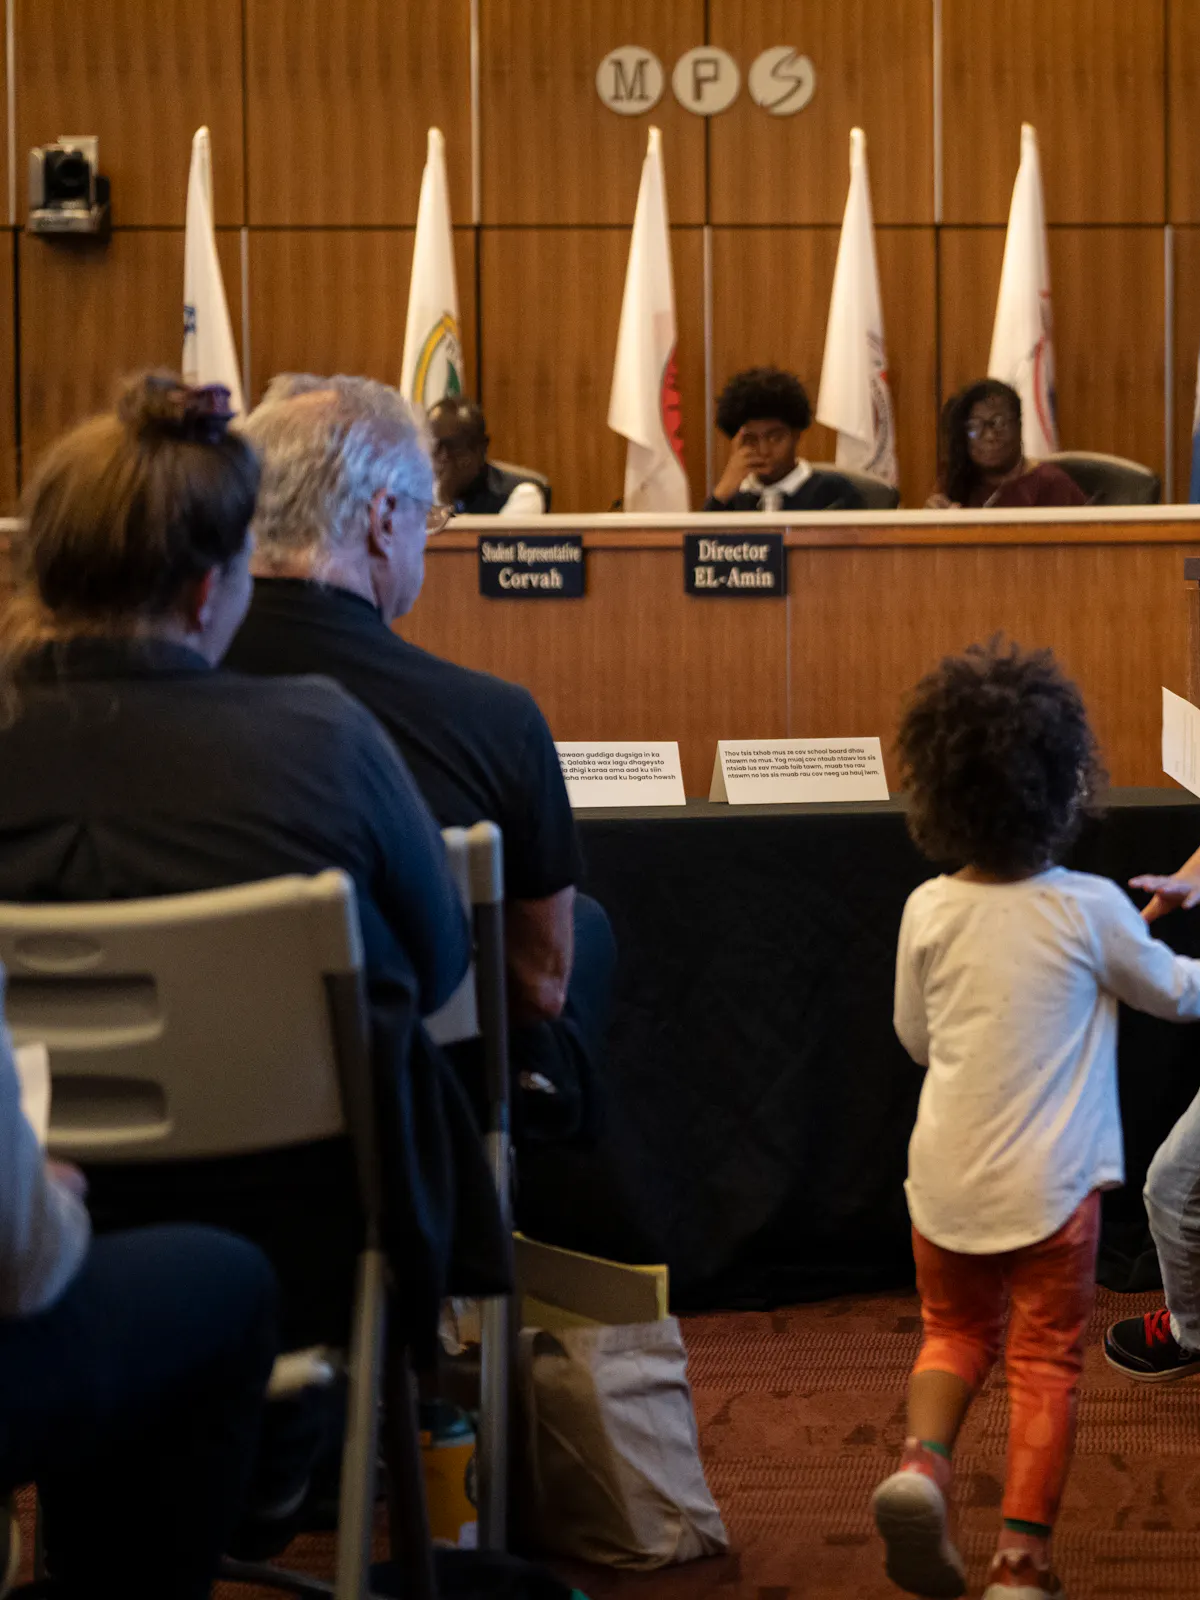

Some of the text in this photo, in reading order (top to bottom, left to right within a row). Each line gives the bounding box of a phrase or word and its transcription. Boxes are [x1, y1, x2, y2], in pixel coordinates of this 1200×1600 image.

[609, 50, 804, 109] MPS
[482, 541, 582, 566] Student Representative
[698, 539, 770, 562] Director
[499, 567, 563, 589] Corvah
[694, 566, 775, 588] EL-Amin
[586, 751, 614, 759] guddiga
[615, 751, 642, 759] dugsiga
